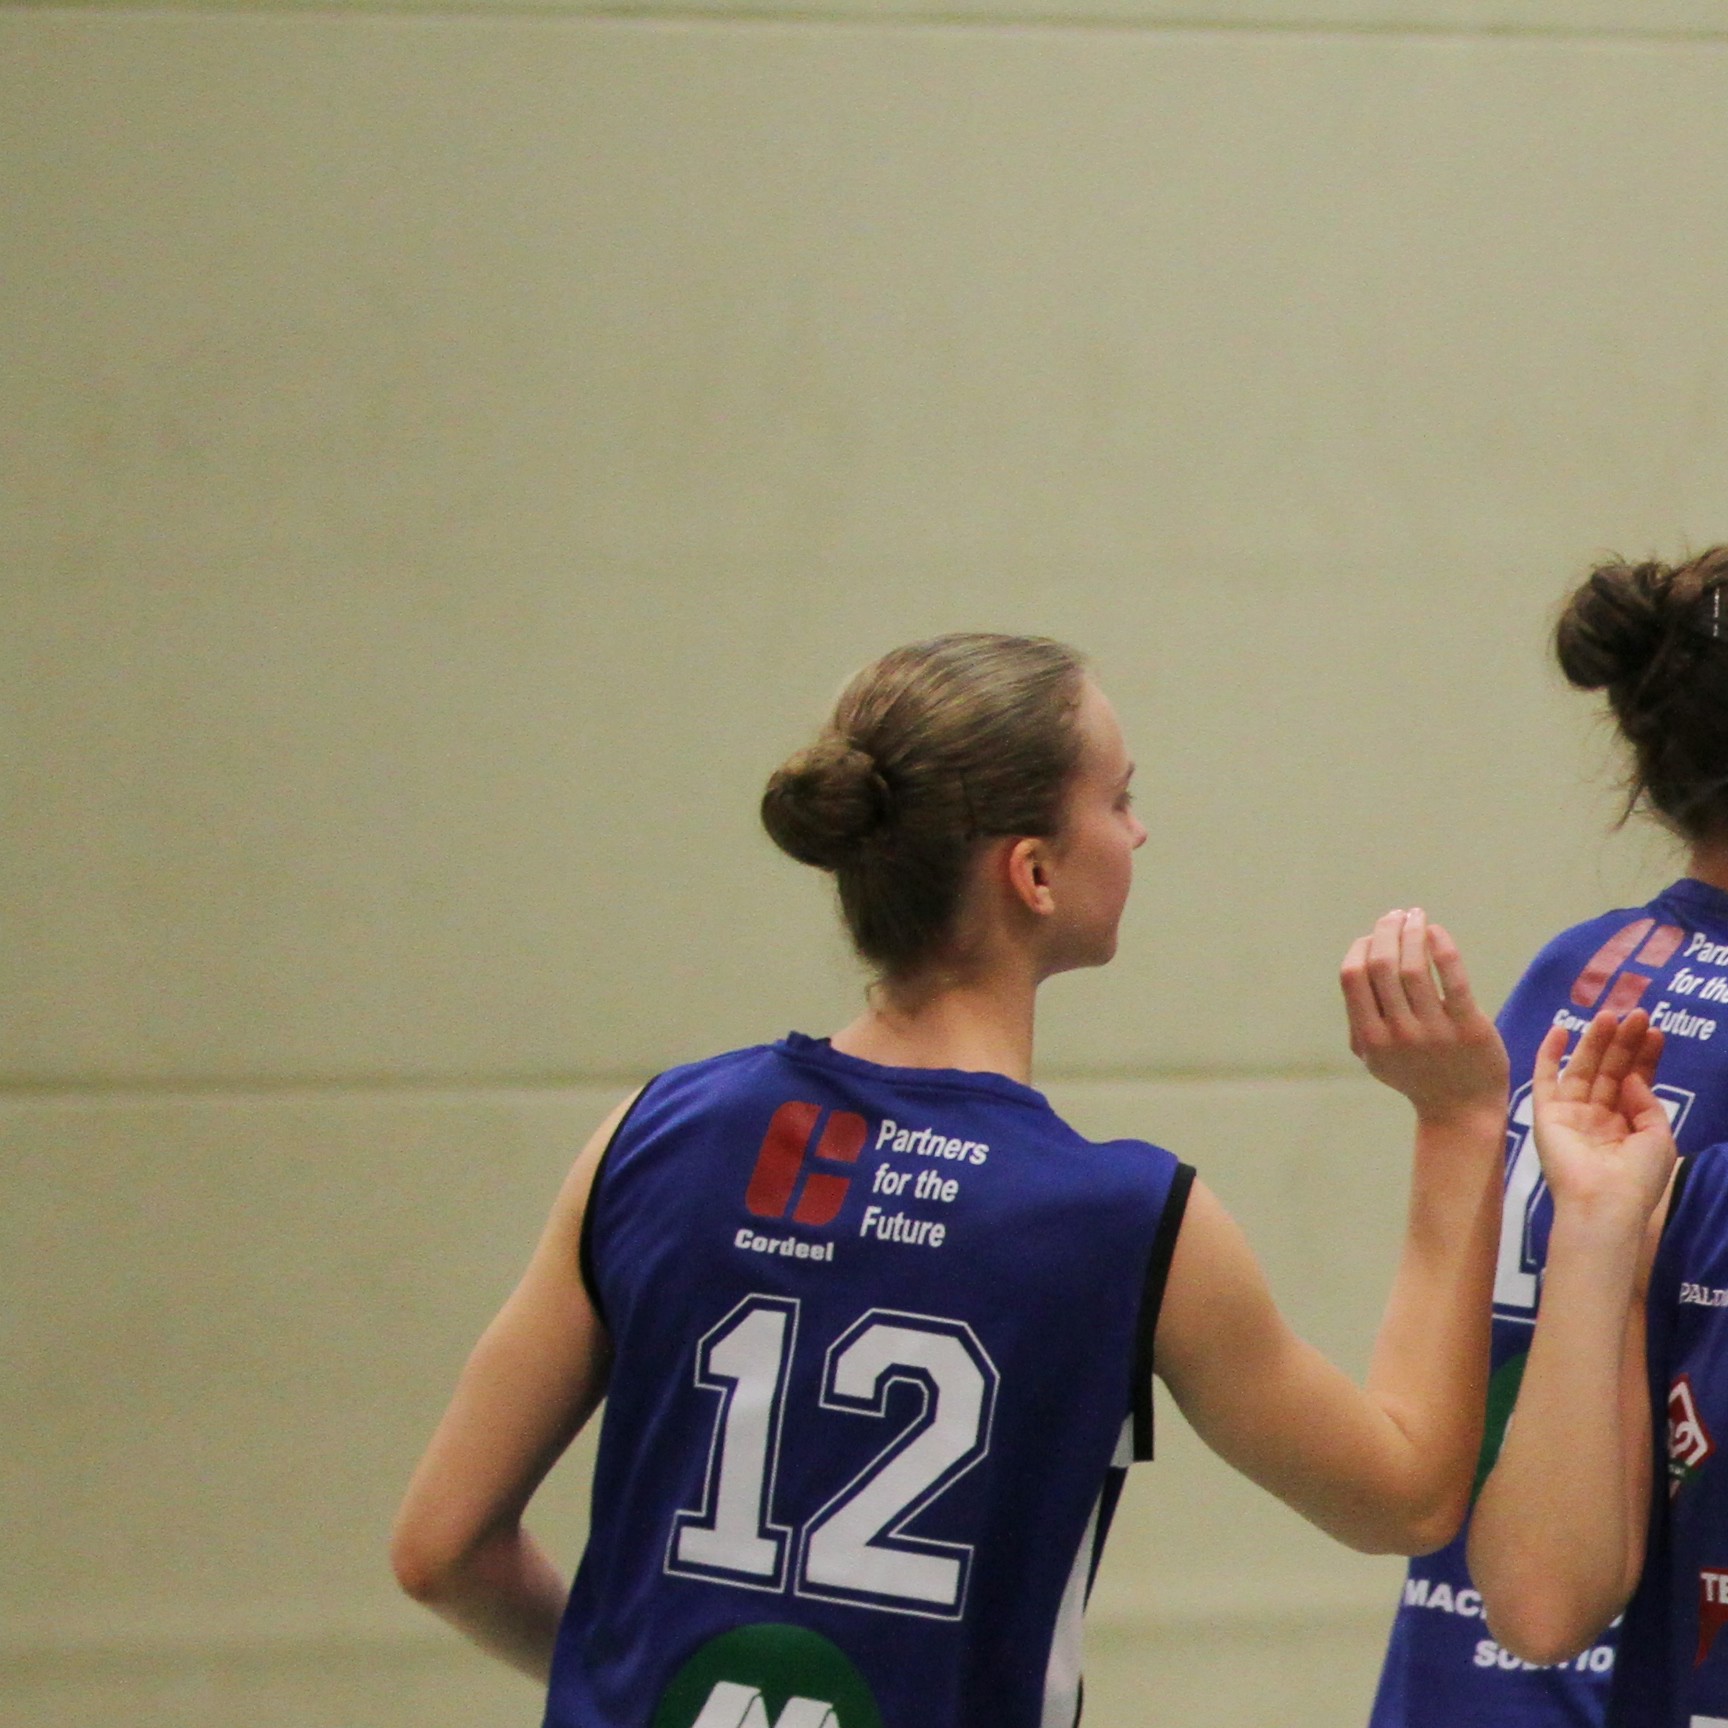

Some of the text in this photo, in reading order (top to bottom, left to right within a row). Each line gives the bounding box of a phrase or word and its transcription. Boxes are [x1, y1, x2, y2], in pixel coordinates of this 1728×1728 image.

[1667, 967, 1703, 996] for
[1649, 1001, 1717, 1041] Future
[874, 1119, 990, 1165] Partners
[872, 1163, 960, 1203] for the
[734, 1228, 834, 1262] Cordeel
[859, 1205, 947, 1248] Future
[663, 1293, 1000, 1620] 12
